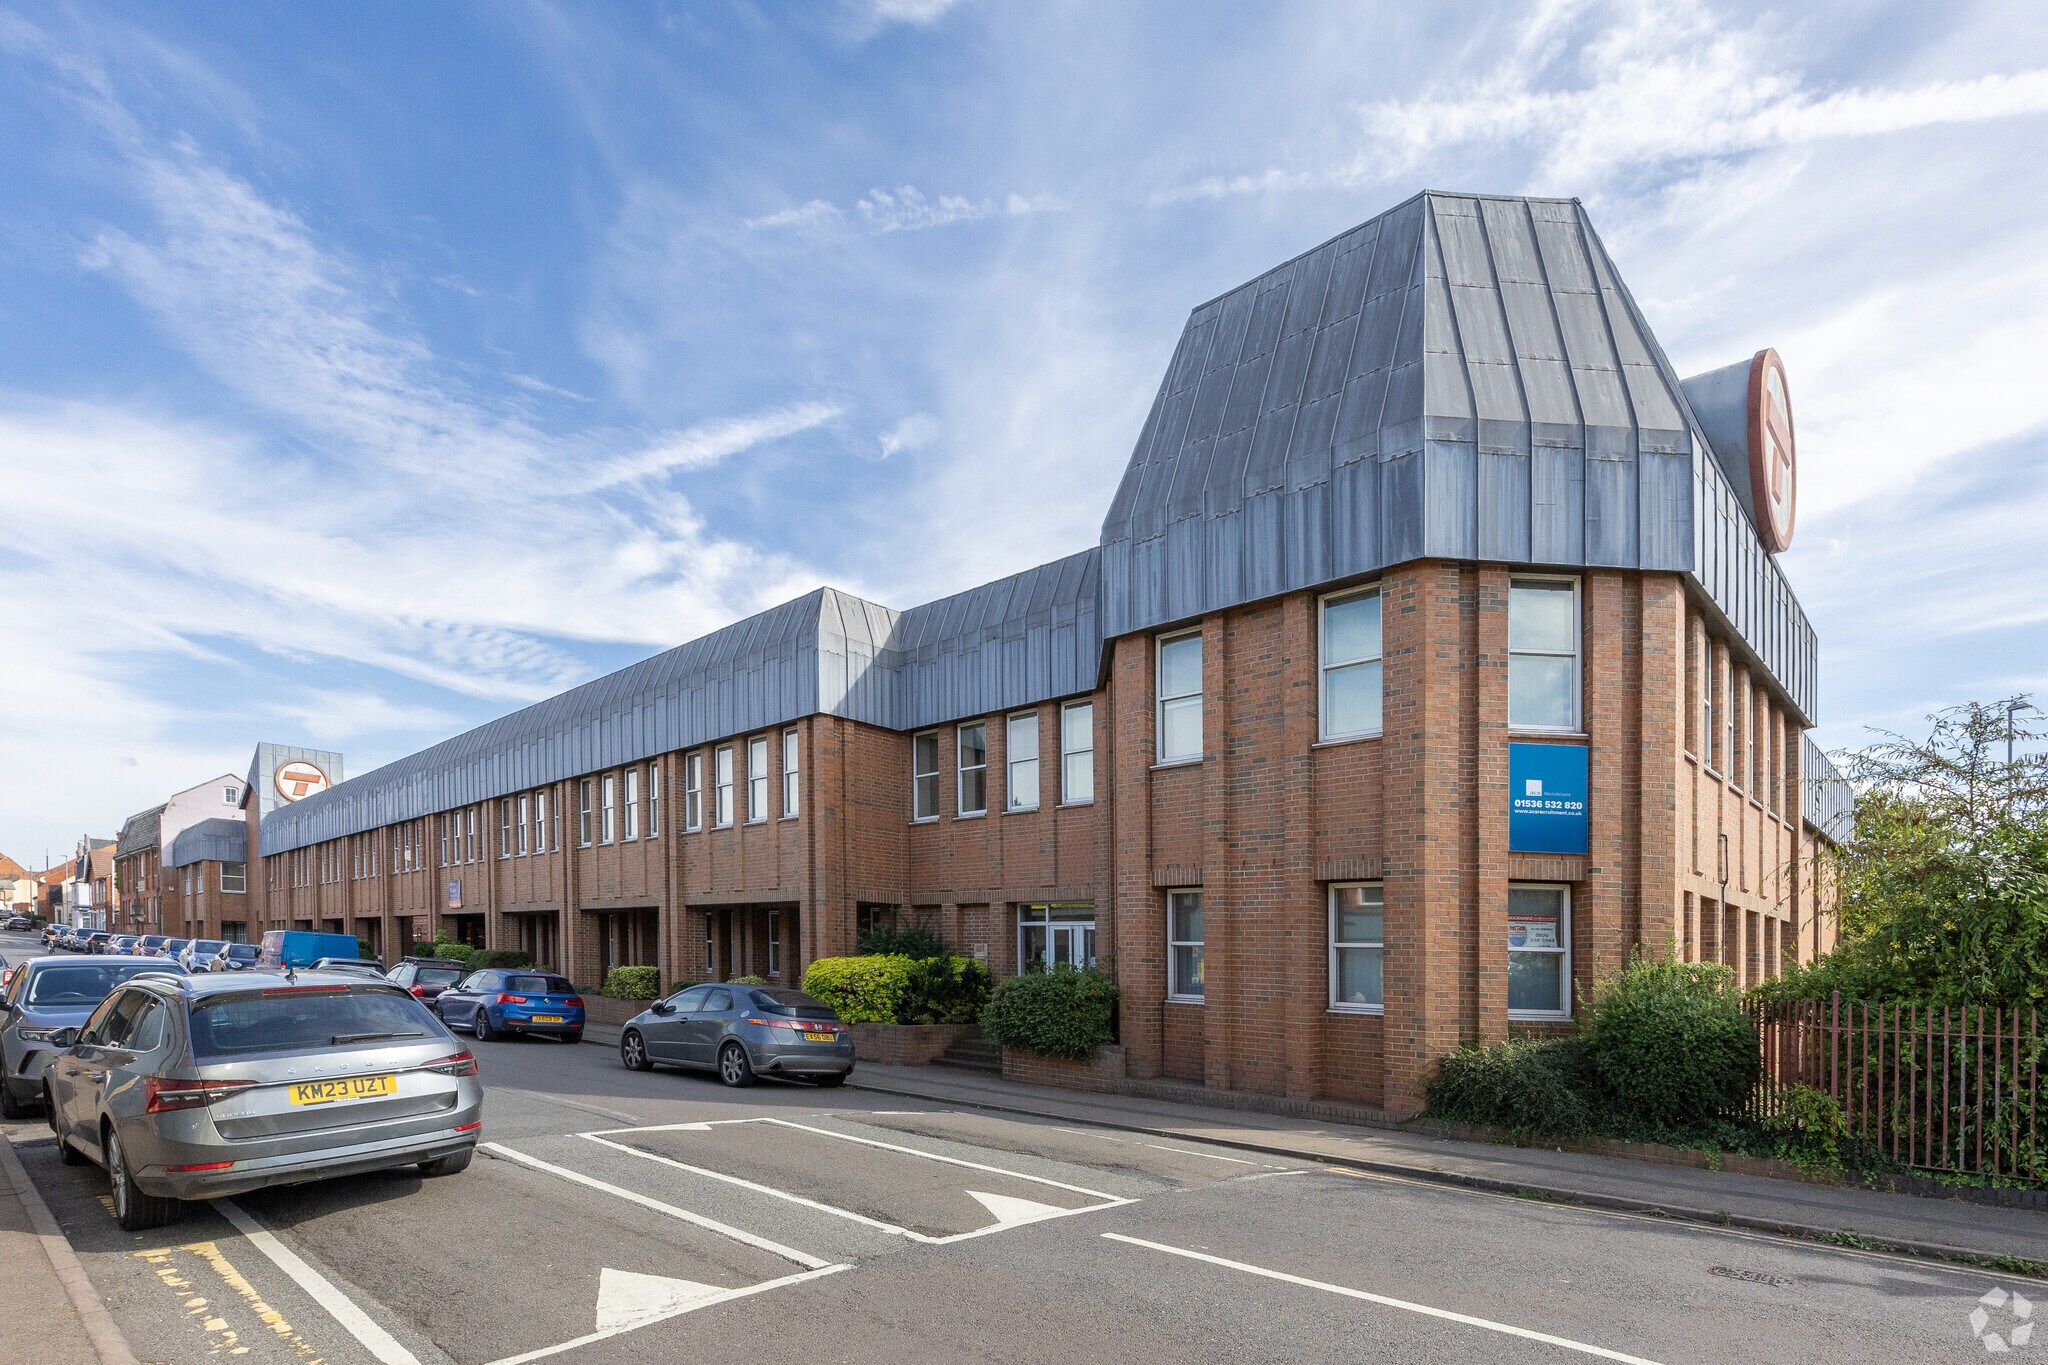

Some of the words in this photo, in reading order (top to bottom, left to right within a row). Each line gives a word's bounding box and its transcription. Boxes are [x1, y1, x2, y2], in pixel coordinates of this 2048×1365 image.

[1514, 799, 1543, 808] 01536
[1545, 800, 1562, 809] 532
[1564, 801, 1583, 810] 820
[297, 1081, 349, 1100] KM23
[353, 1077, 387, 1093] UZT
